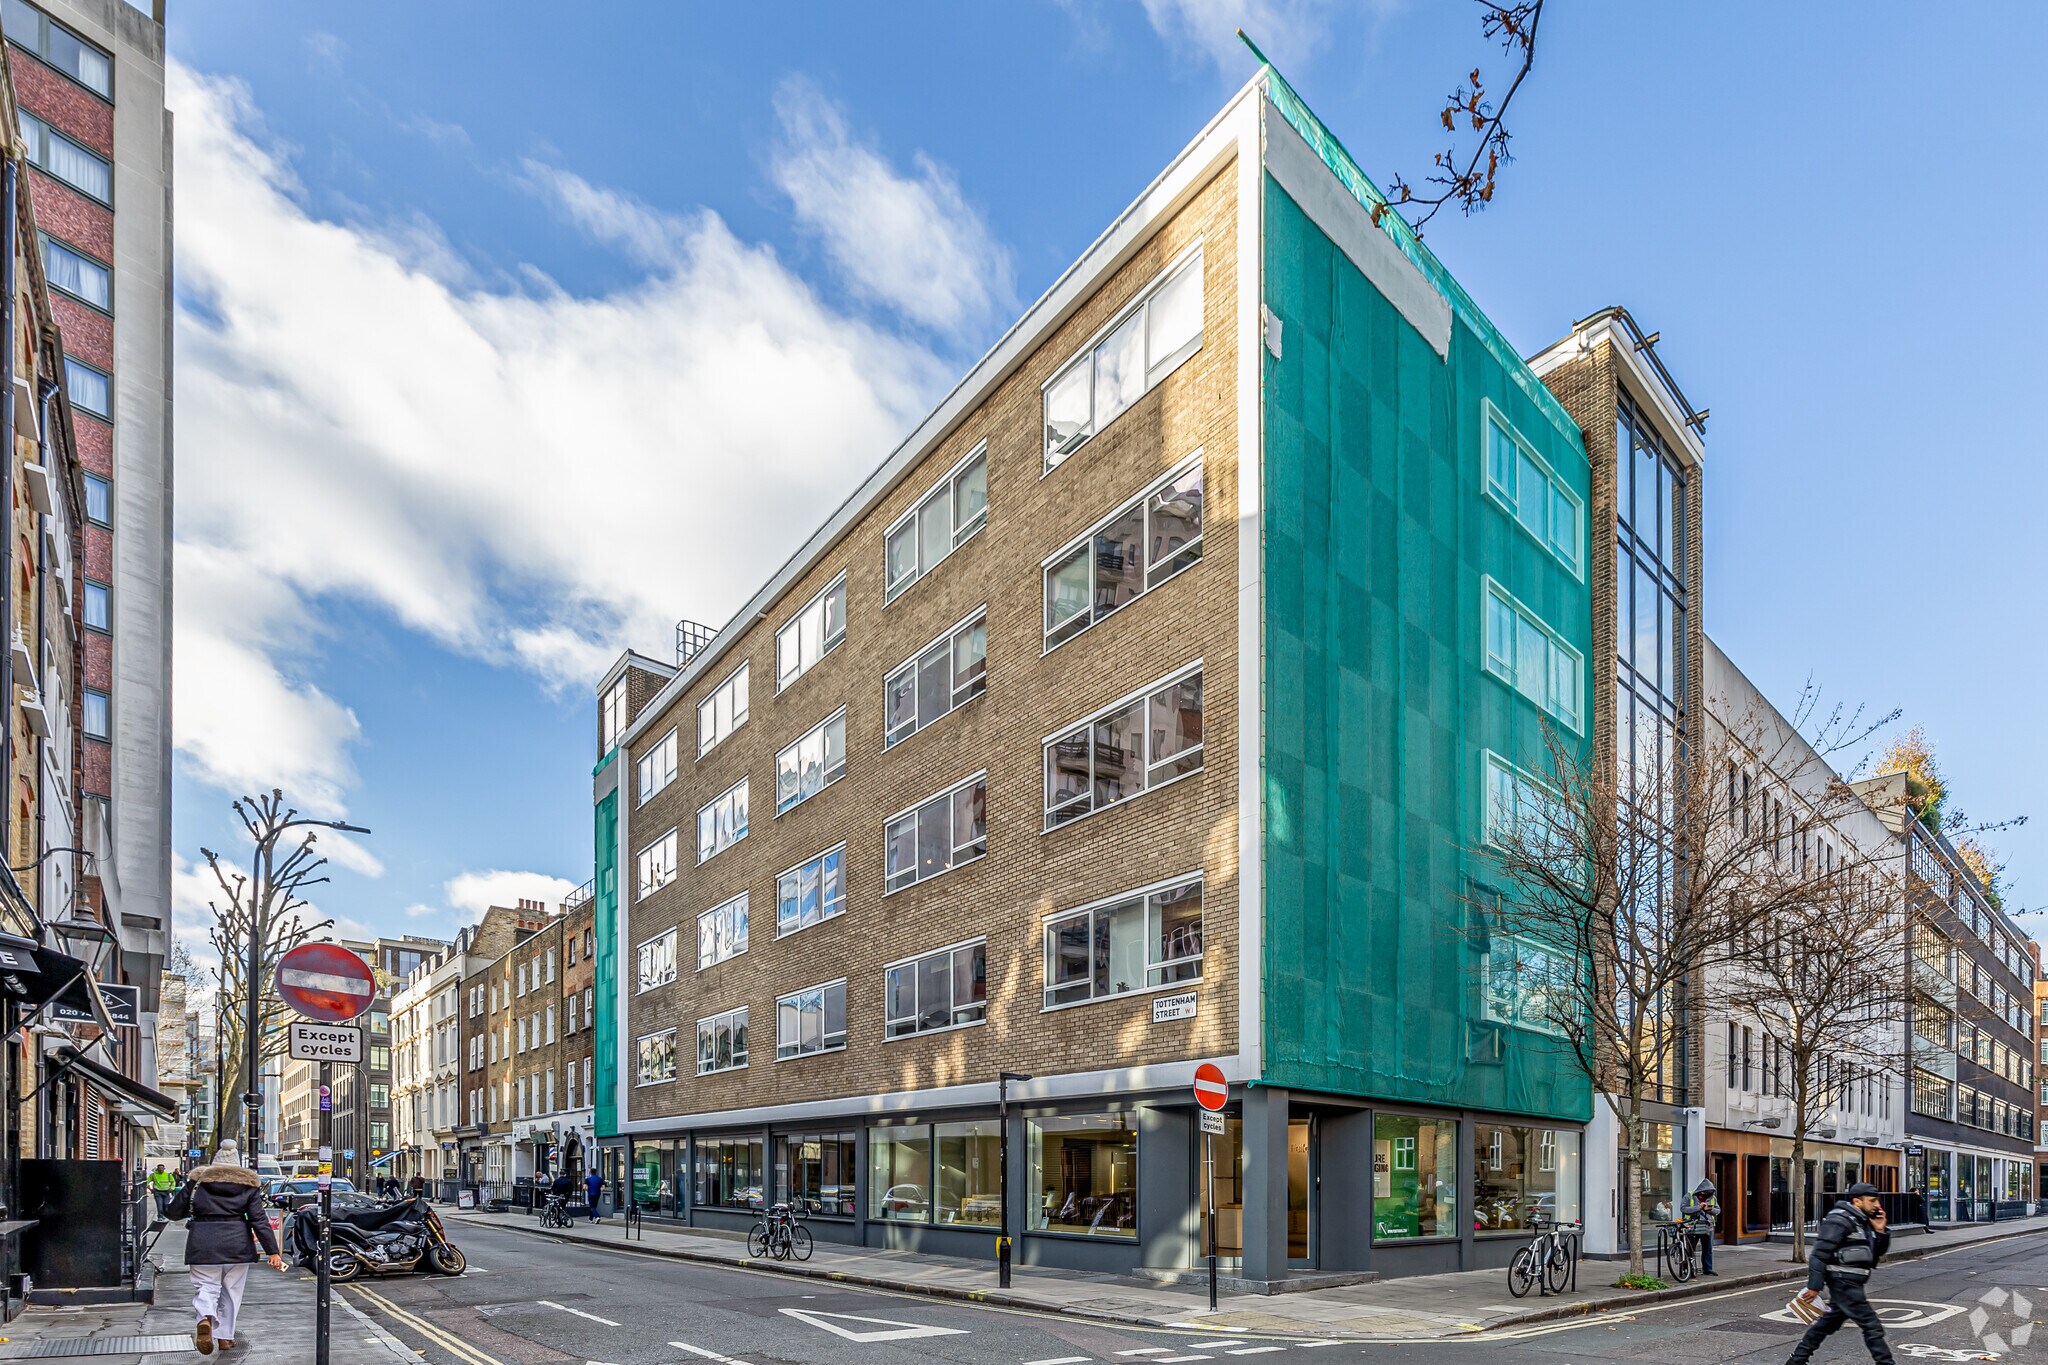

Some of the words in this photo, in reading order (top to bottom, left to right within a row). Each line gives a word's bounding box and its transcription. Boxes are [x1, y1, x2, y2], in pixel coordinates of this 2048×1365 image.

[1155, 994, 1196, 1009] TOTTENHAM
[60, 1008, 78, 1016] 020
[1155, 1007, 1180, 1019] STREET
[298, 1028, 355, 1044] Except
[300, 1044, 352, 1056] cycles
[1202, 1113, 1223, 1123] Except
[1203, 1122, 1222, 1131] cycles
